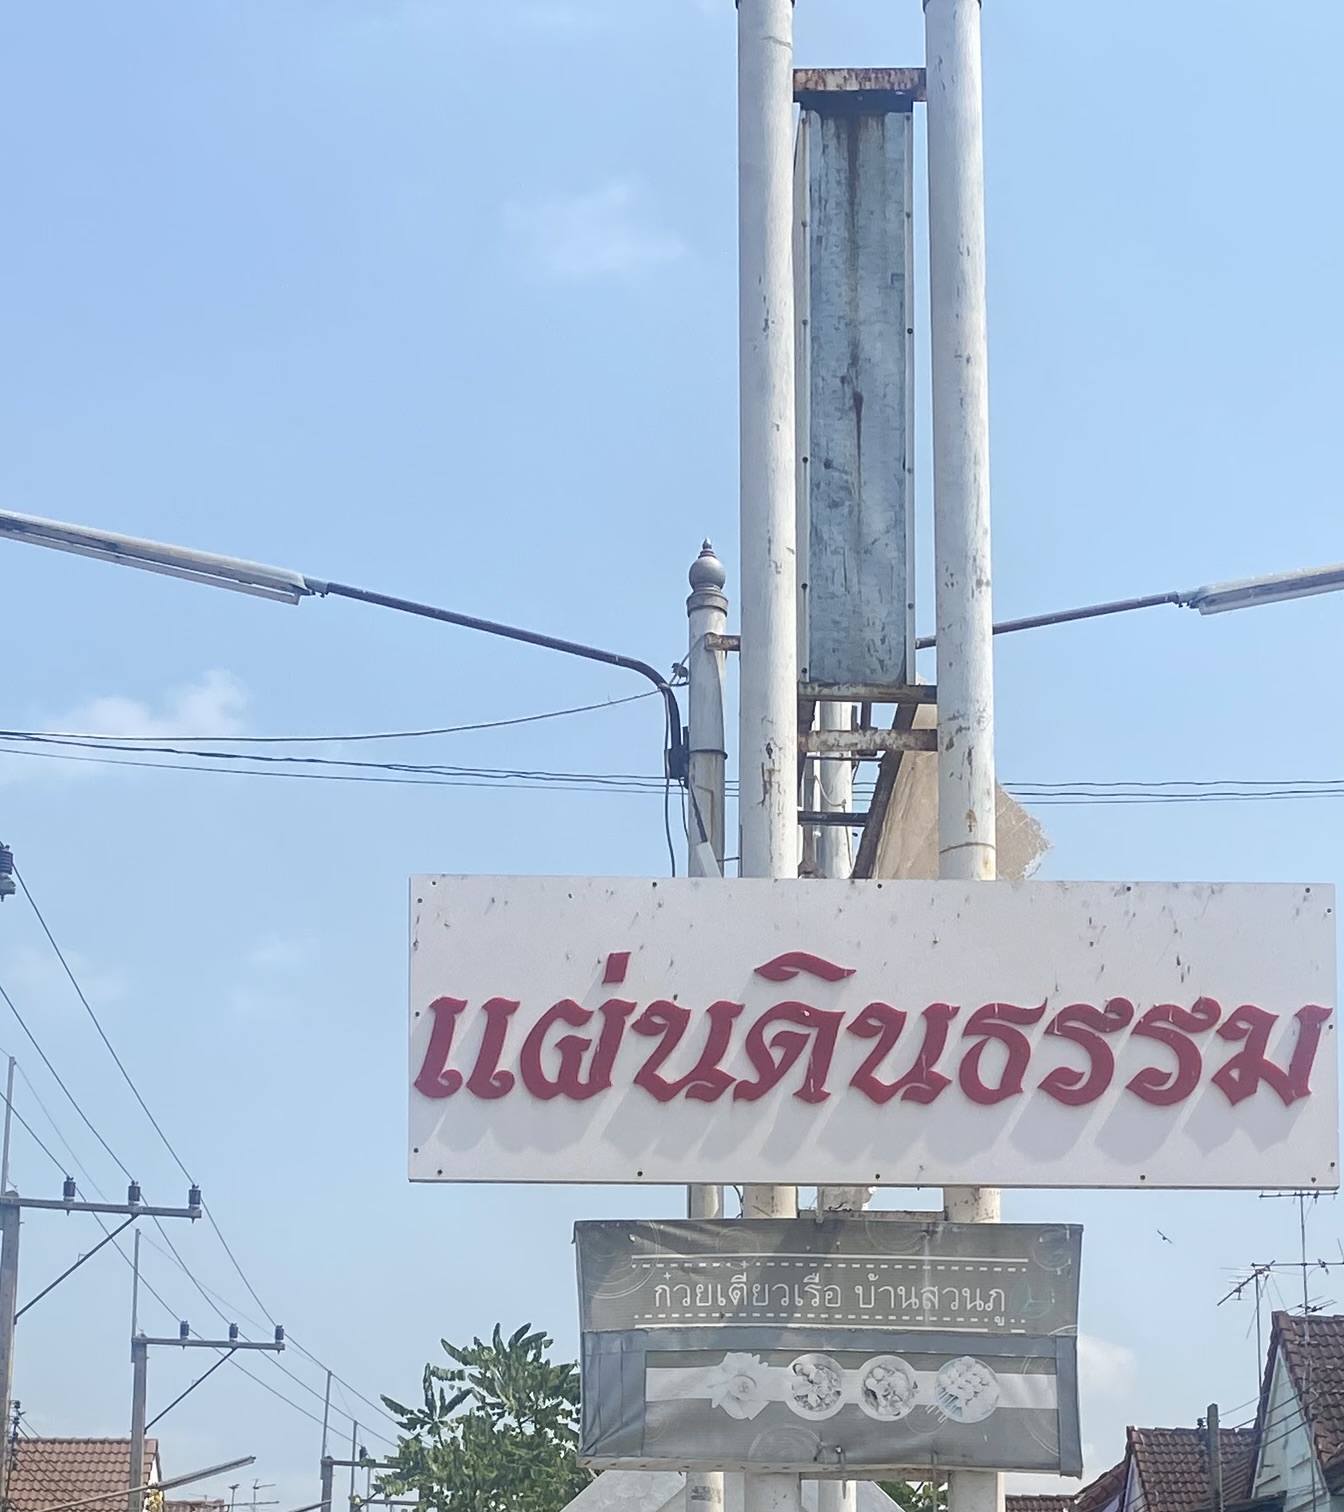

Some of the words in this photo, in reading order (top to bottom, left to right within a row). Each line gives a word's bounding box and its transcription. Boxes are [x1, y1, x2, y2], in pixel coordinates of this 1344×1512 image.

[414, 951, 1334, 1107] แผ่นดินธรรม
[654, 1260, 842, 1308] ก๋วยเตี๋ยวเรือ
[854, 1272, 1006, 1326] บ้านสวนภู
